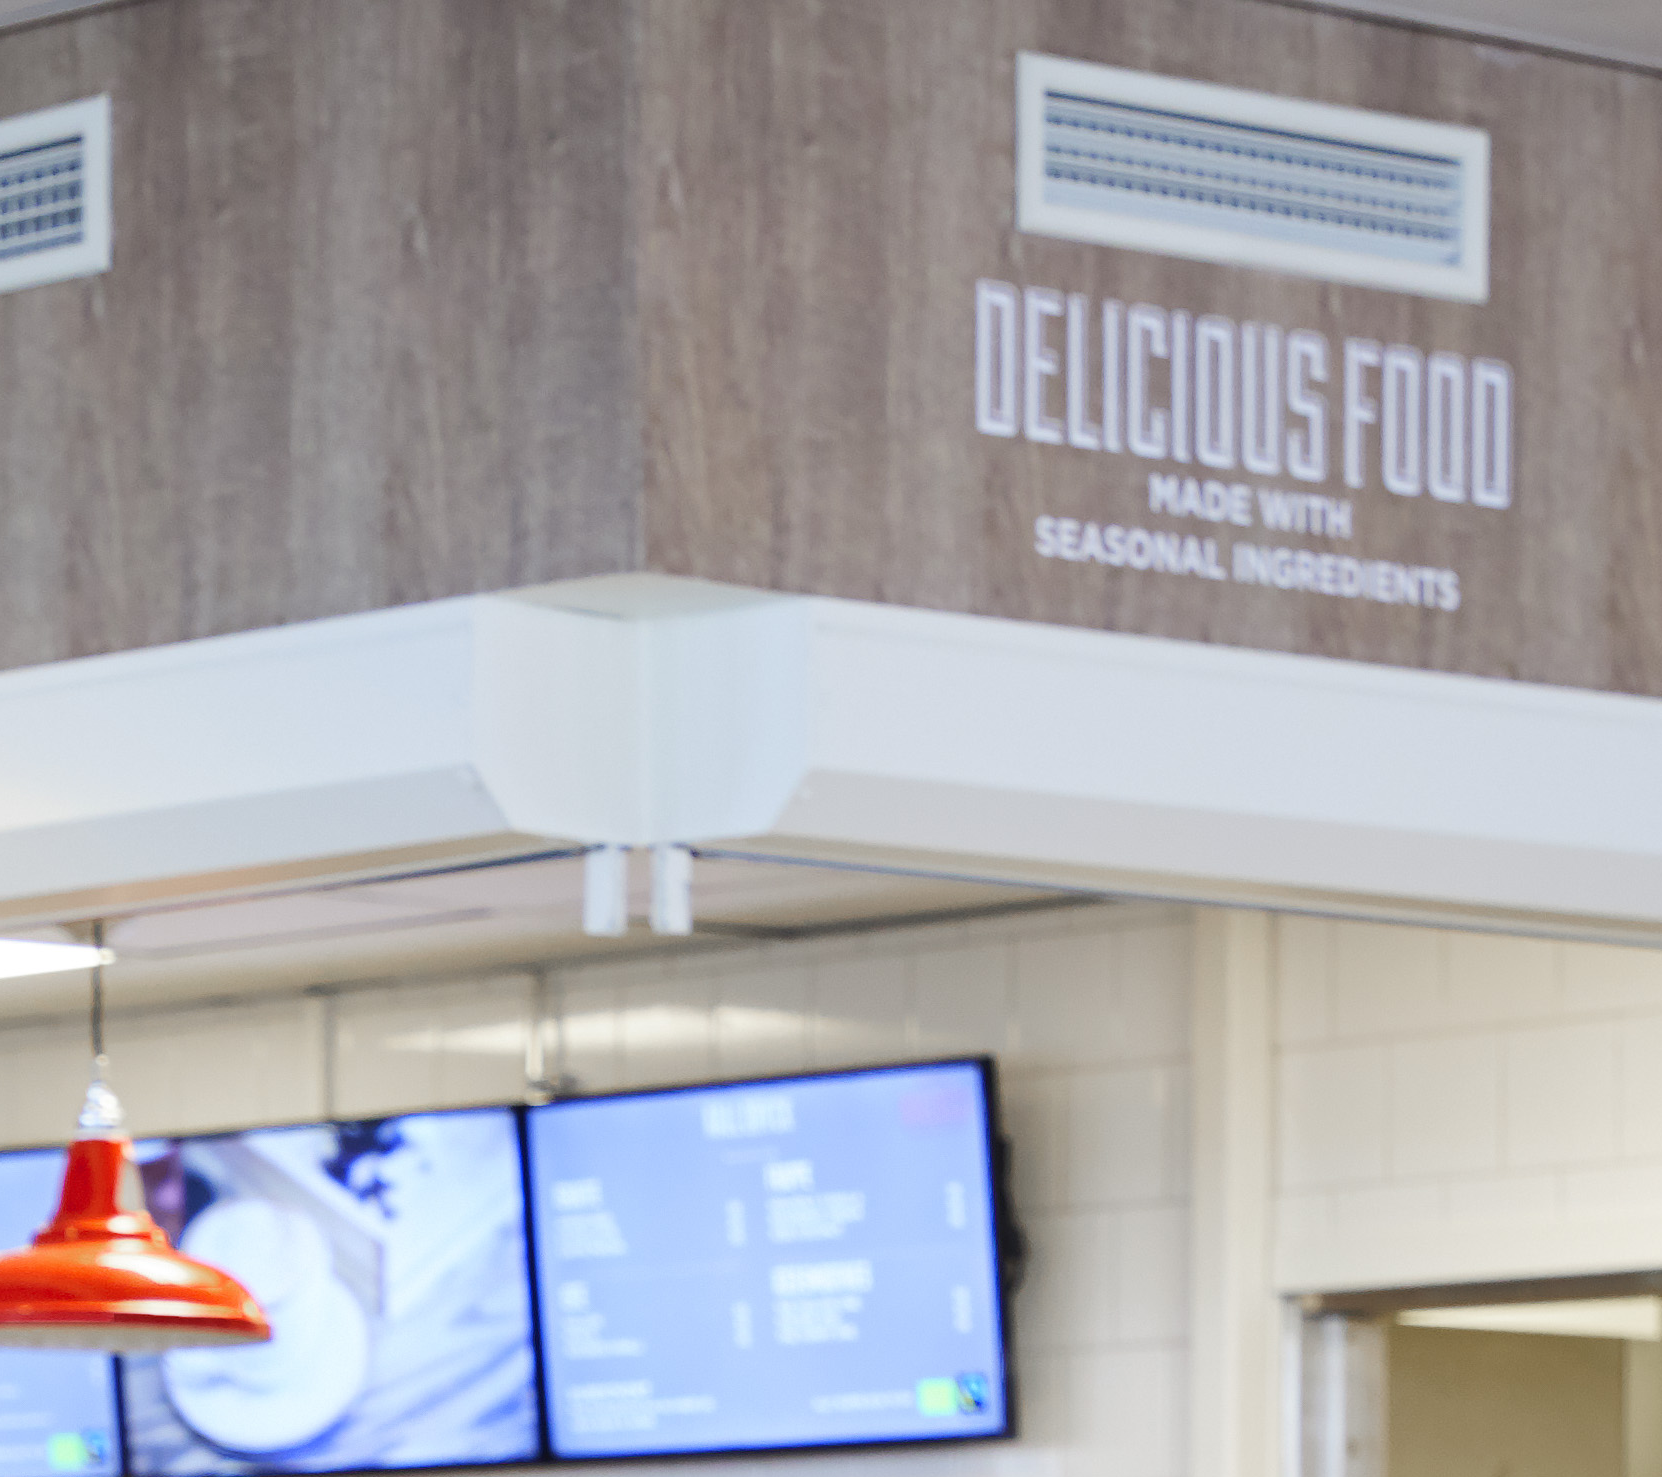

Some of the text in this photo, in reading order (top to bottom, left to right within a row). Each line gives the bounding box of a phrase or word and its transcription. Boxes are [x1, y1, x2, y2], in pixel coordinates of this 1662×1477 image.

[976, 278, 1514, 510] DELICIOUS FOOD
[1148, 473, 1352, 538] MADE WITH
[1034, 516, 1461, 612] SEASONAL INGREDIENTS
